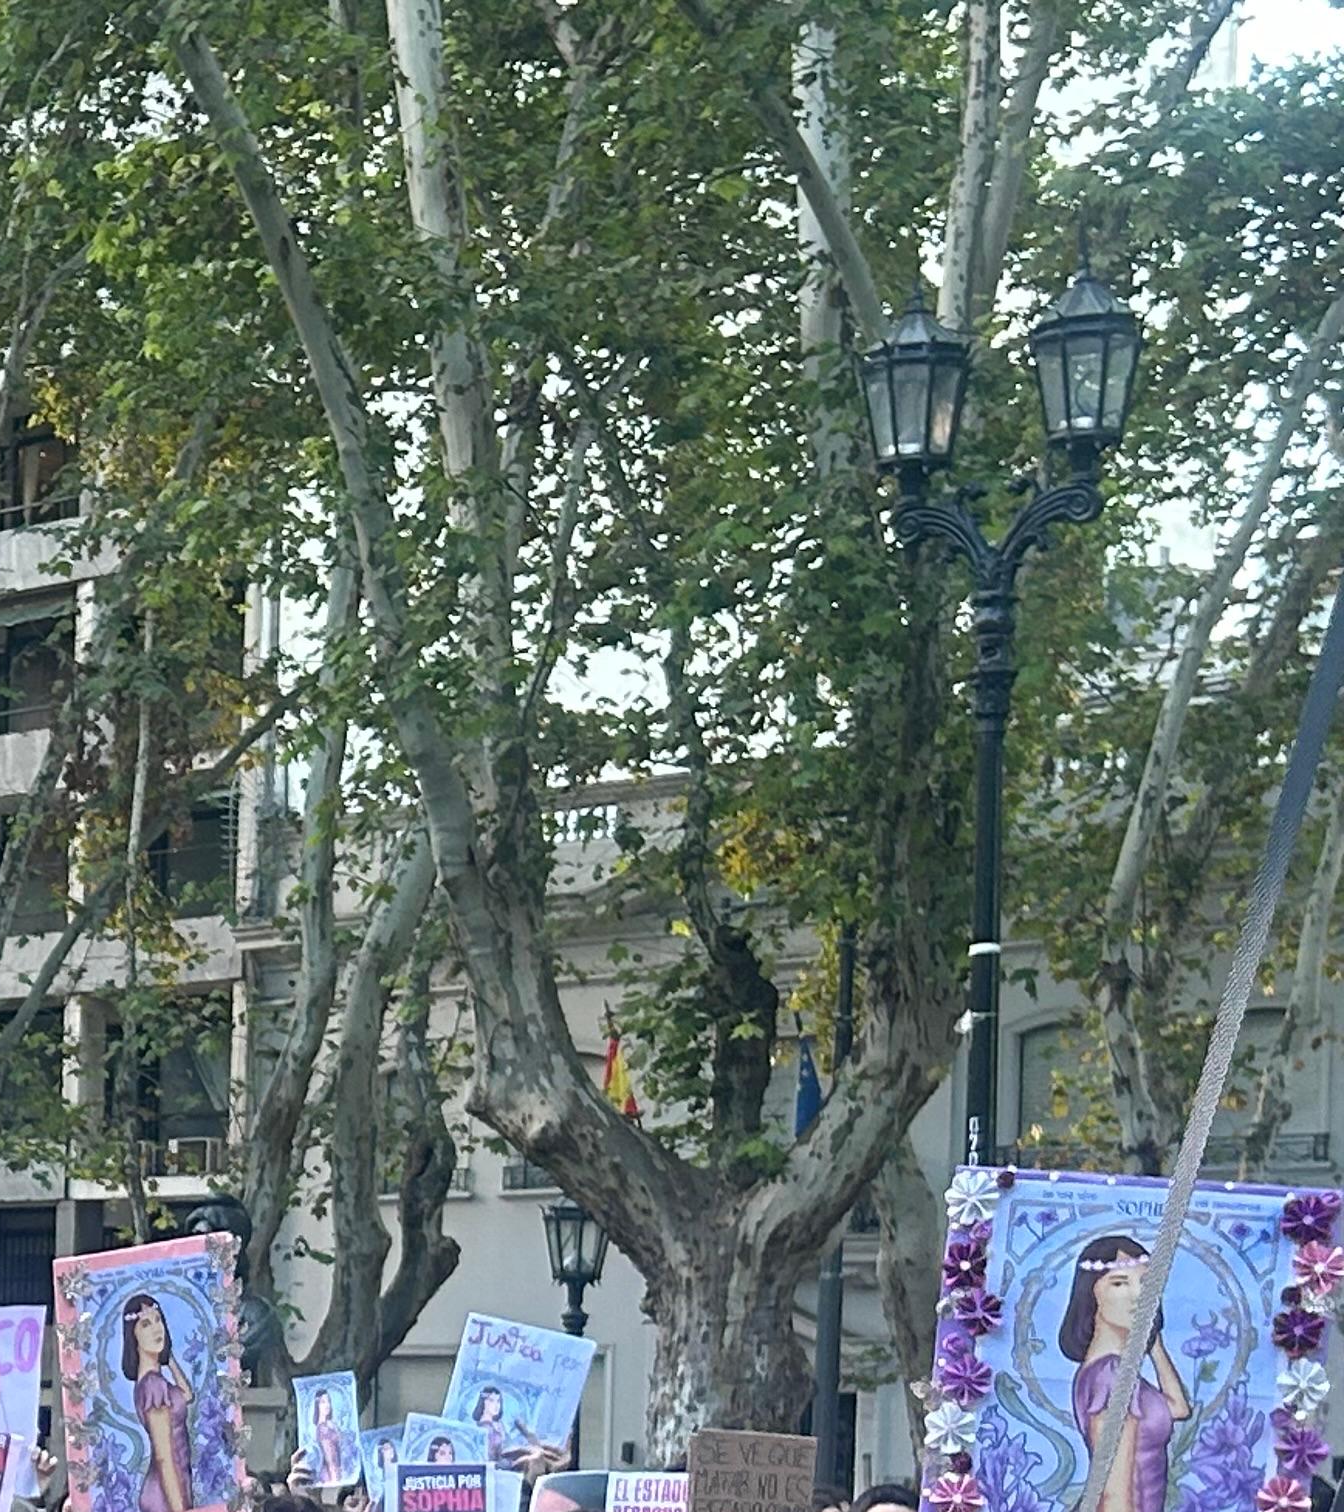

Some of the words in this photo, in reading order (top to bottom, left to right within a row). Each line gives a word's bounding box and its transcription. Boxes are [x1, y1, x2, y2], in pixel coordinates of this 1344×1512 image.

[402, 1475, 456, 1491] JUSTICIA
[458, 1474, 482, 1489] POR
[615, 1478, 629, 1501] EL
[758, 1473, 778, 1500] NO
[402, 1489, 483, 1512] SOPHIA
